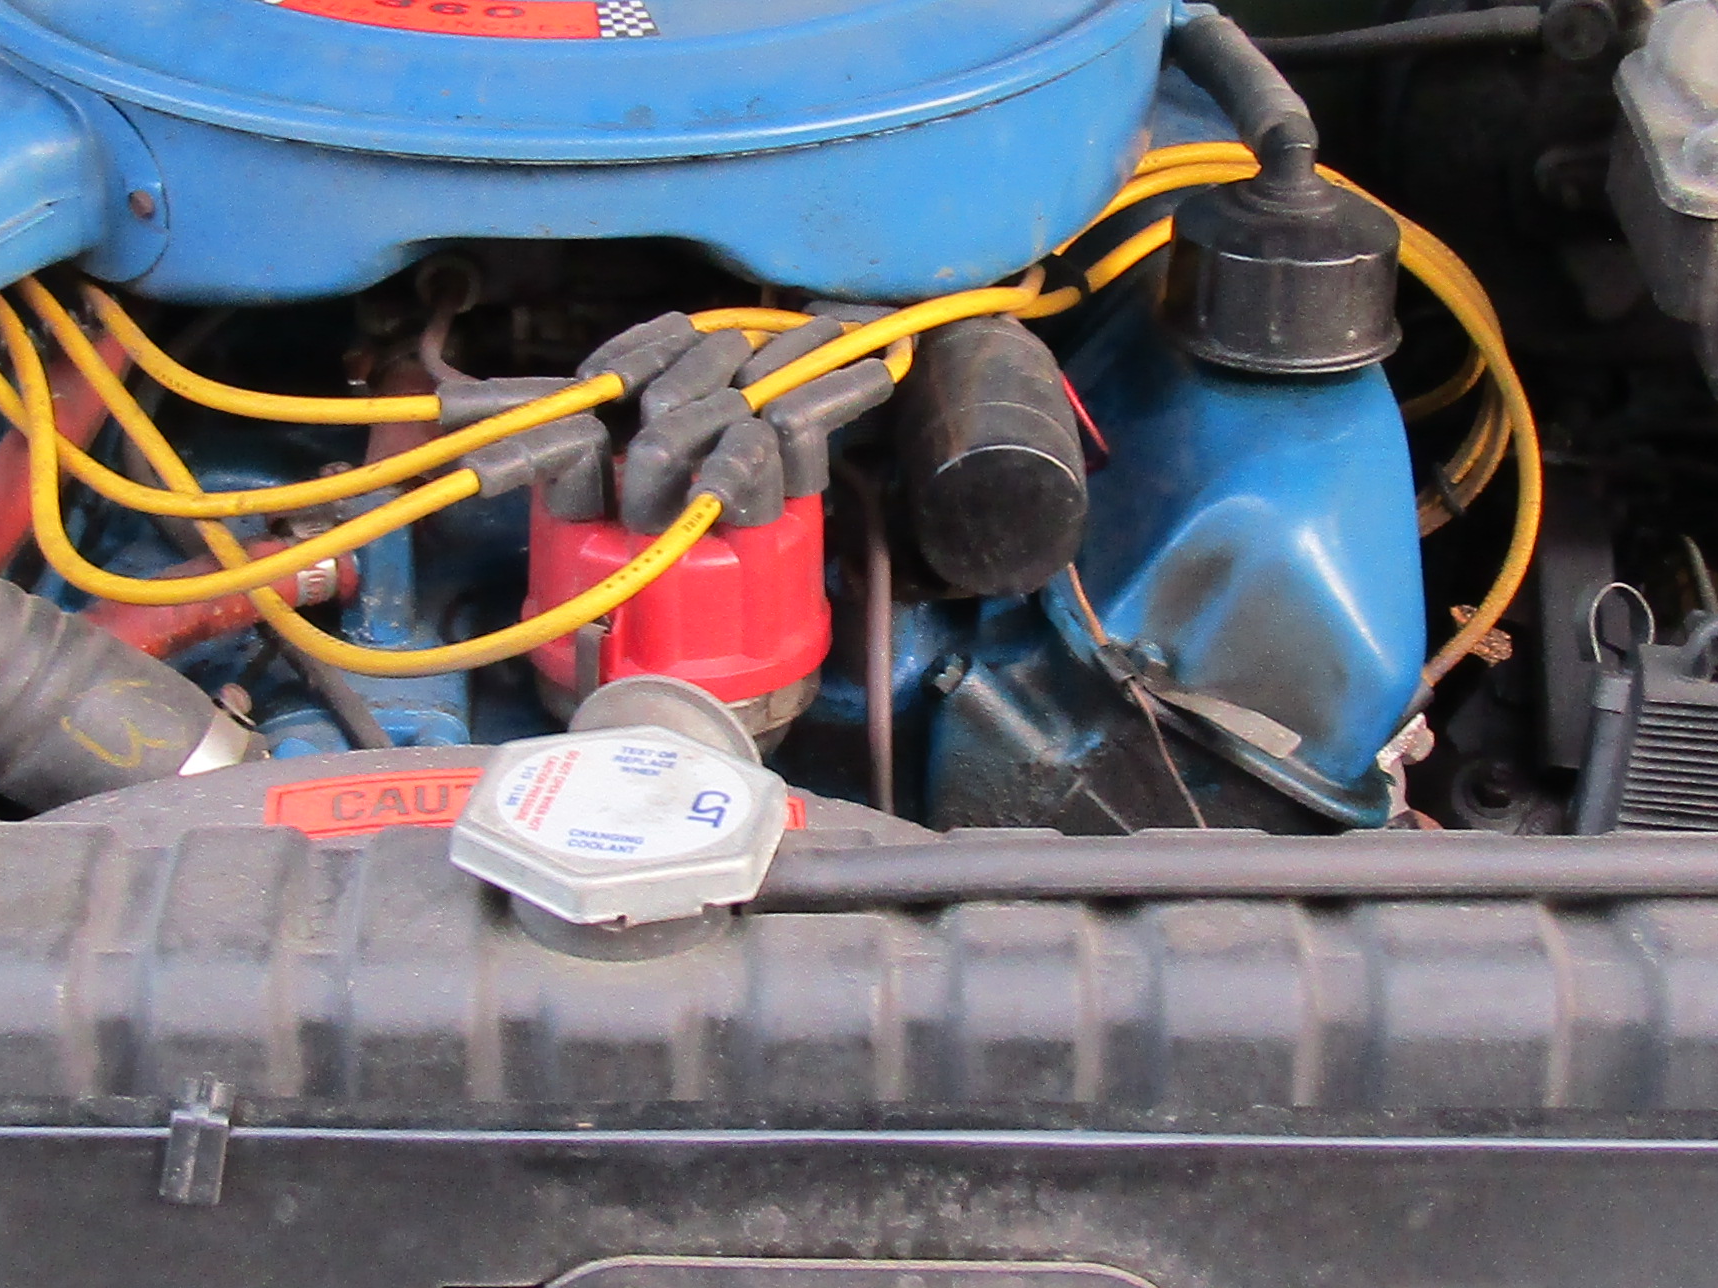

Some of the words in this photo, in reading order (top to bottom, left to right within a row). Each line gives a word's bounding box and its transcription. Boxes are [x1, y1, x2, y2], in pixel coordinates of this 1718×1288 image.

[438, 19, 582, 32] INCHES
[612, 754, 675, 769] REPLACE
[567, 827, 645, 845] CHANGING
[566, 838, 639, 854] COOLANT
